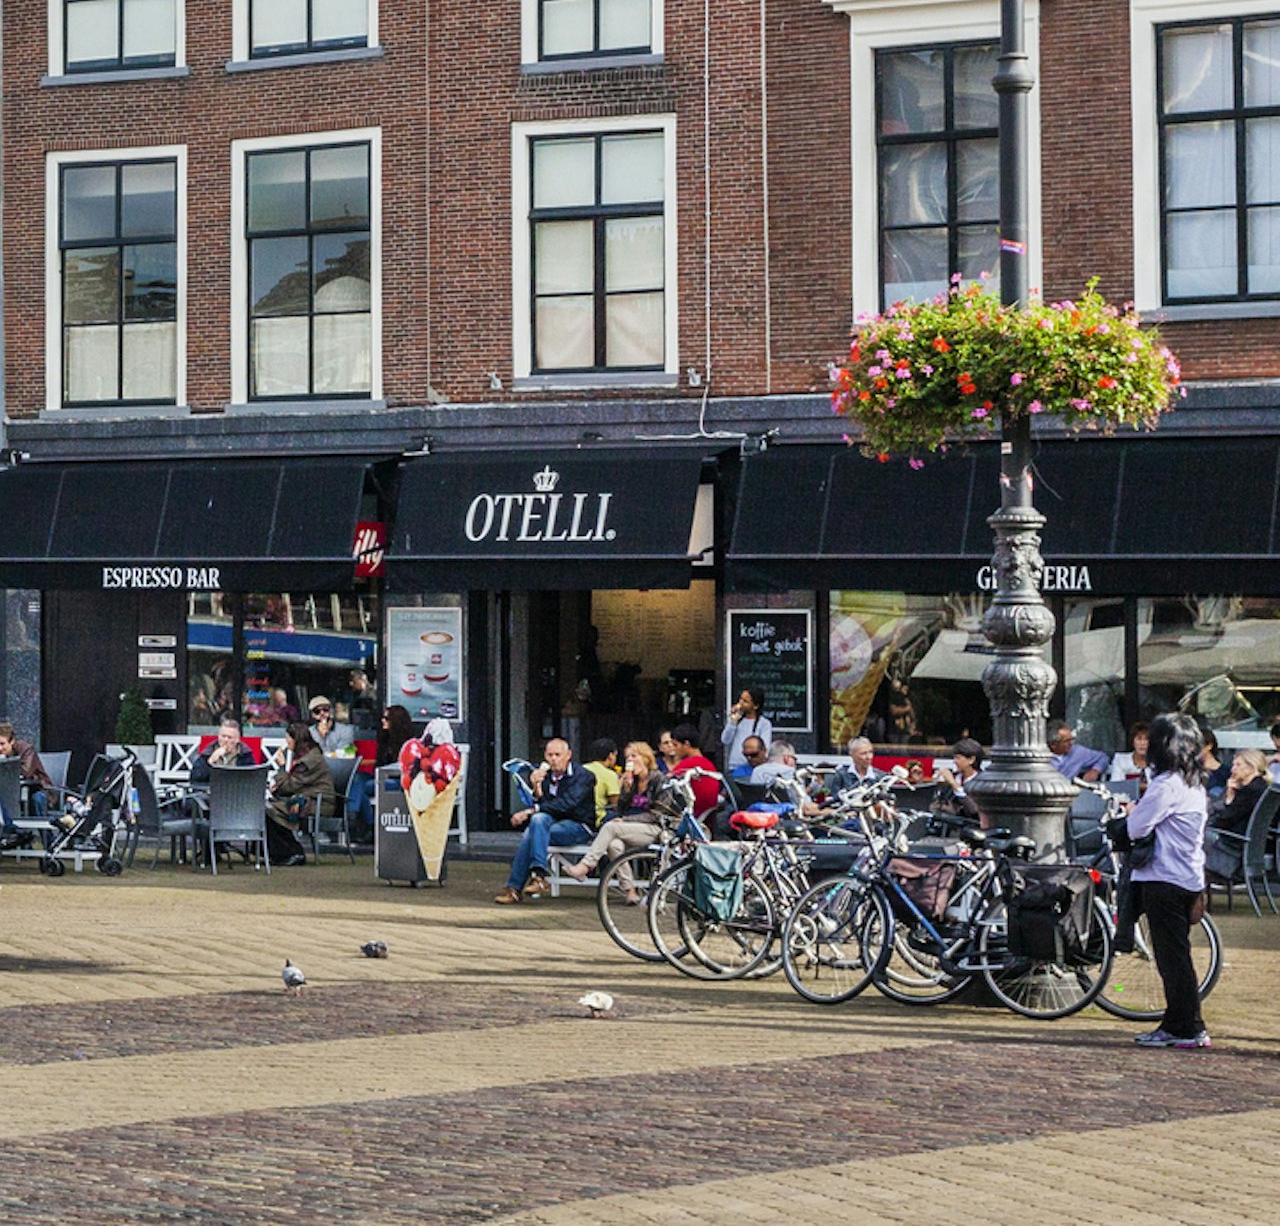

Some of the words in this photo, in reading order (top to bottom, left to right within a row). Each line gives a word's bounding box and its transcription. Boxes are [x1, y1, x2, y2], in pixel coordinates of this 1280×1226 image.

[352, 528, 385, 573] illy
[102, 566, 182, 589] ESPRESSO
[186, 566, 220, 589] BAR
[740, 622, 776, 640] koffie
